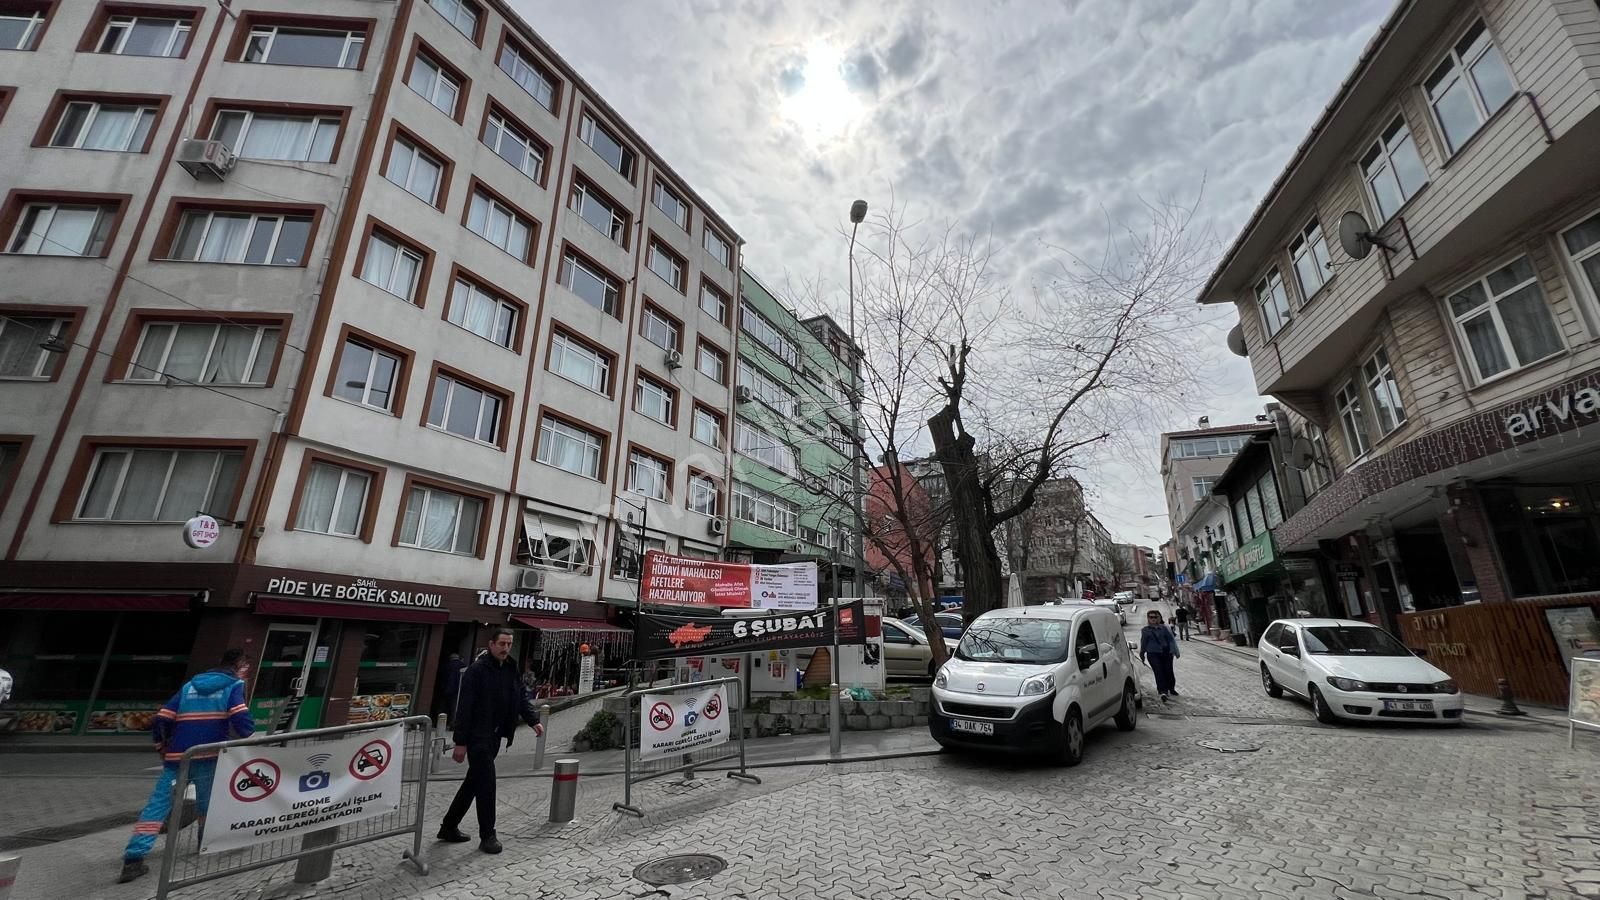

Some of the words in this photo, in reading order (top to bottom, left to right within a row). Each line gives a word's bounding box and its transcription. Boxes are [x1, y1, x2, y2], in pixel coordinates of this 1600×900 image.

[652, 563, 680, 576] HÜDAYİ
[681, 566, 722, 580] MAHALLESİ
[267, 576, 308, 595] PİDE
[312, 582, 332, 598] VE
[335, 583, 387, 603] BÖREK
[389, 590, 442, 608] SALONU
[356, 578, 378, 589] SAHİL
[650, 576, 685, 589] AFETLERE
[477, 590, 509, 607] T&B
[510, 593, 535, 608] gift
[536, 597, 569, 614] shop
[649, 588, 706, 603] HAZIRLANIYOR!
[733, 620, 748, 638] 6
[751, 611, 827, 637] ŞUBAT
[230, 816, 275, 831] KARARI
[279, 808, 318, 824] GEREĞİ
[321, 798, 351, 813] CEZAİ
[353, 792, 383, 806] İŞLEM
[292, 796, 331, 811] UKOME
[254, 806, 363, 837] UYGULANMAKTADIR
